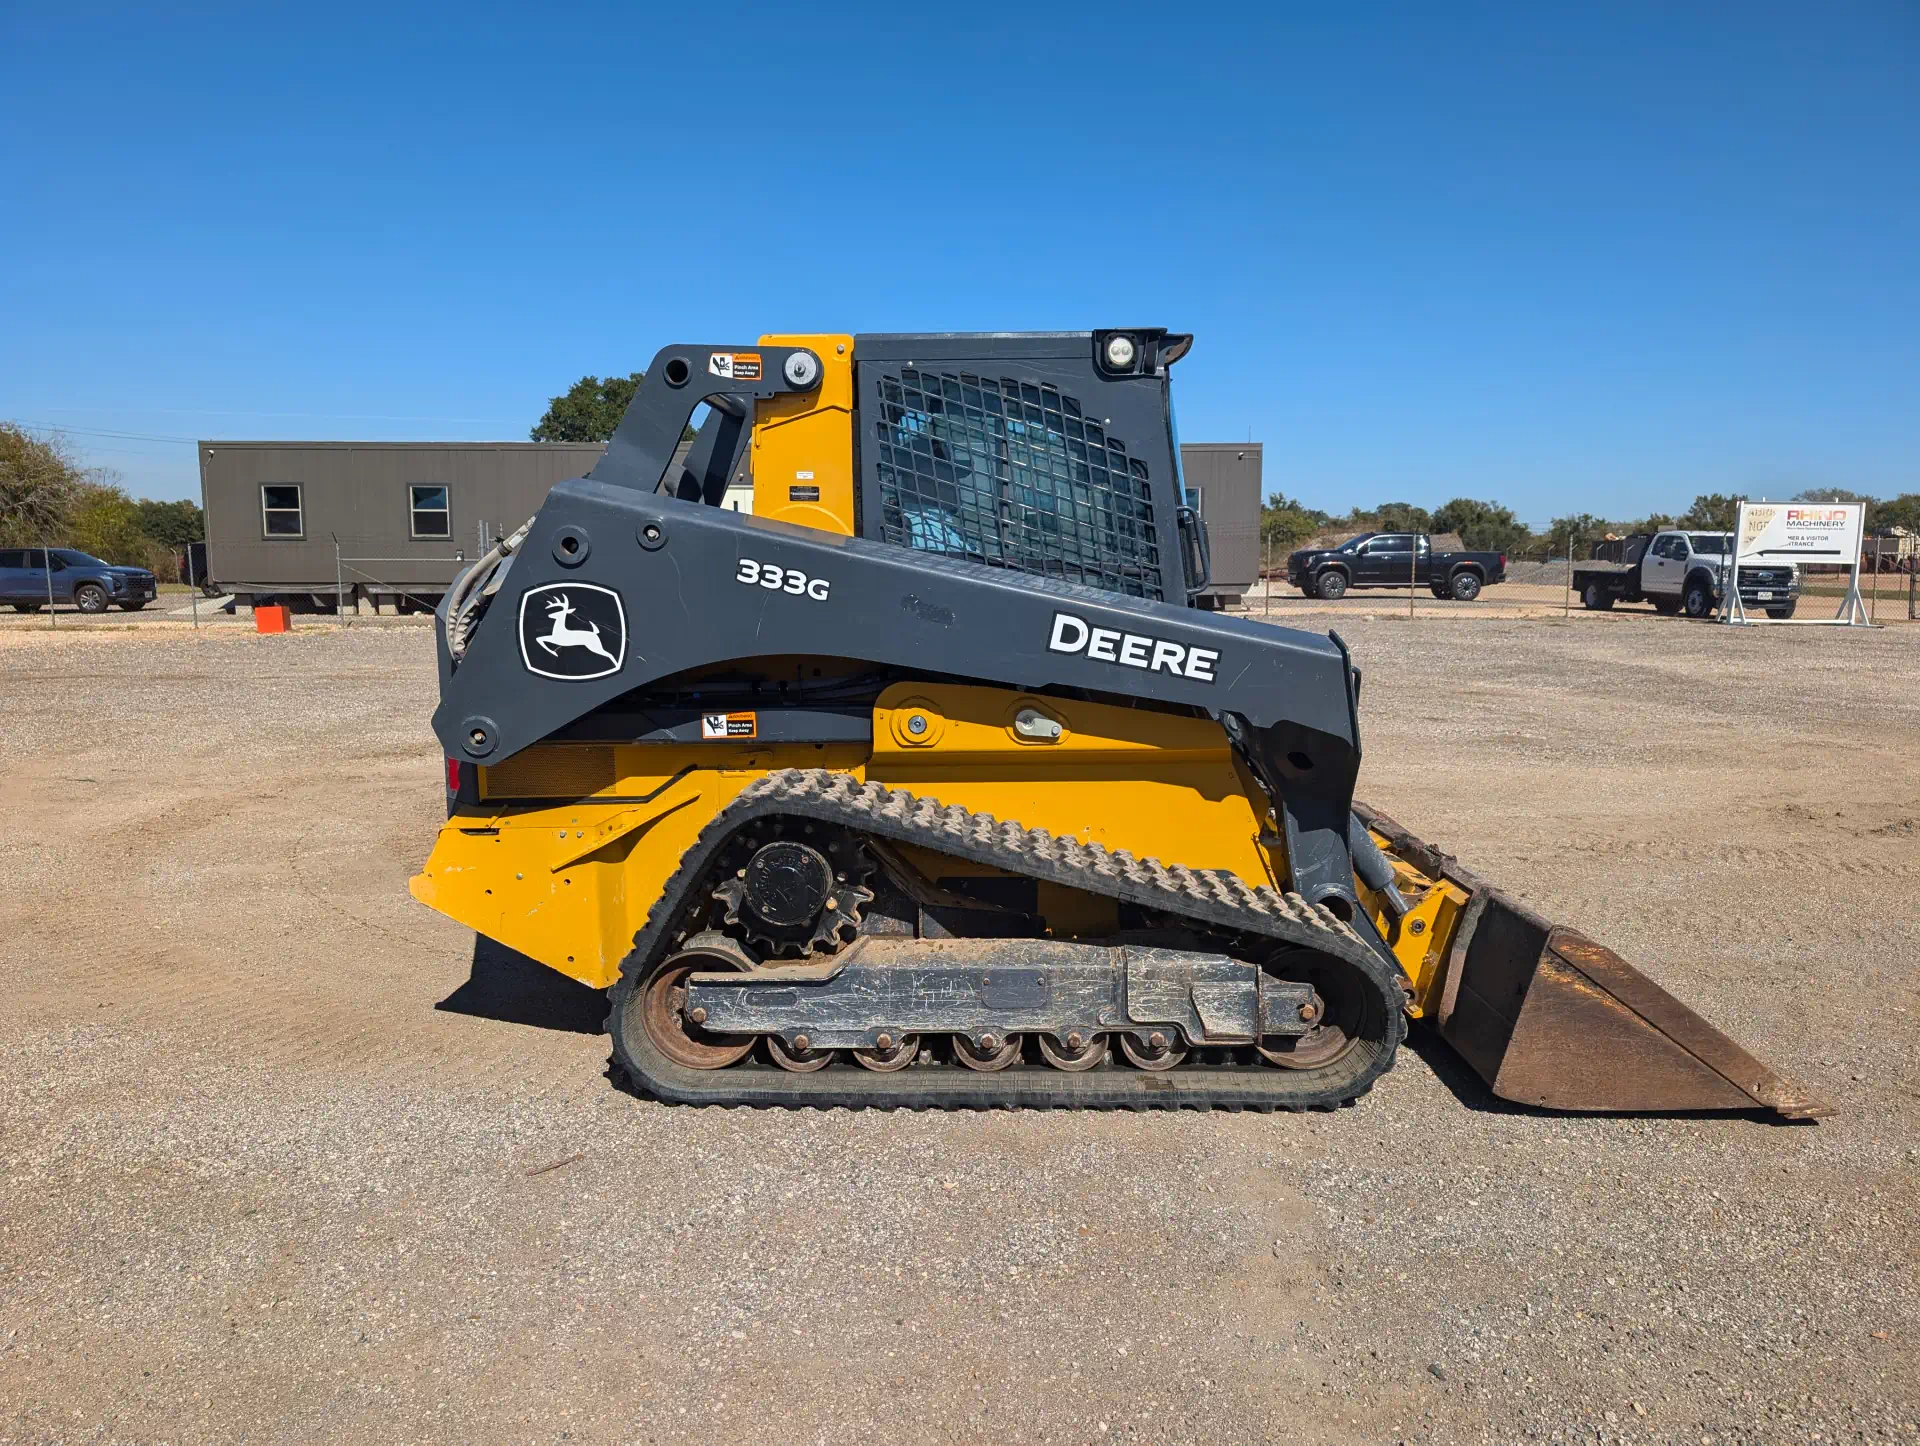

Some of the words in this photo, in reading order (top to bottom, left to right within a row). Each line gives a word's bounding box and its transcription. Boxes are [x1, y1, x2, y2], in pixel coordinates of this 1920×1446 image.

[1787, 510, 1847, 520] RHINO
[736, 558, 830, 601] 333G
[1050, 613, 1219, 681] DEERE
